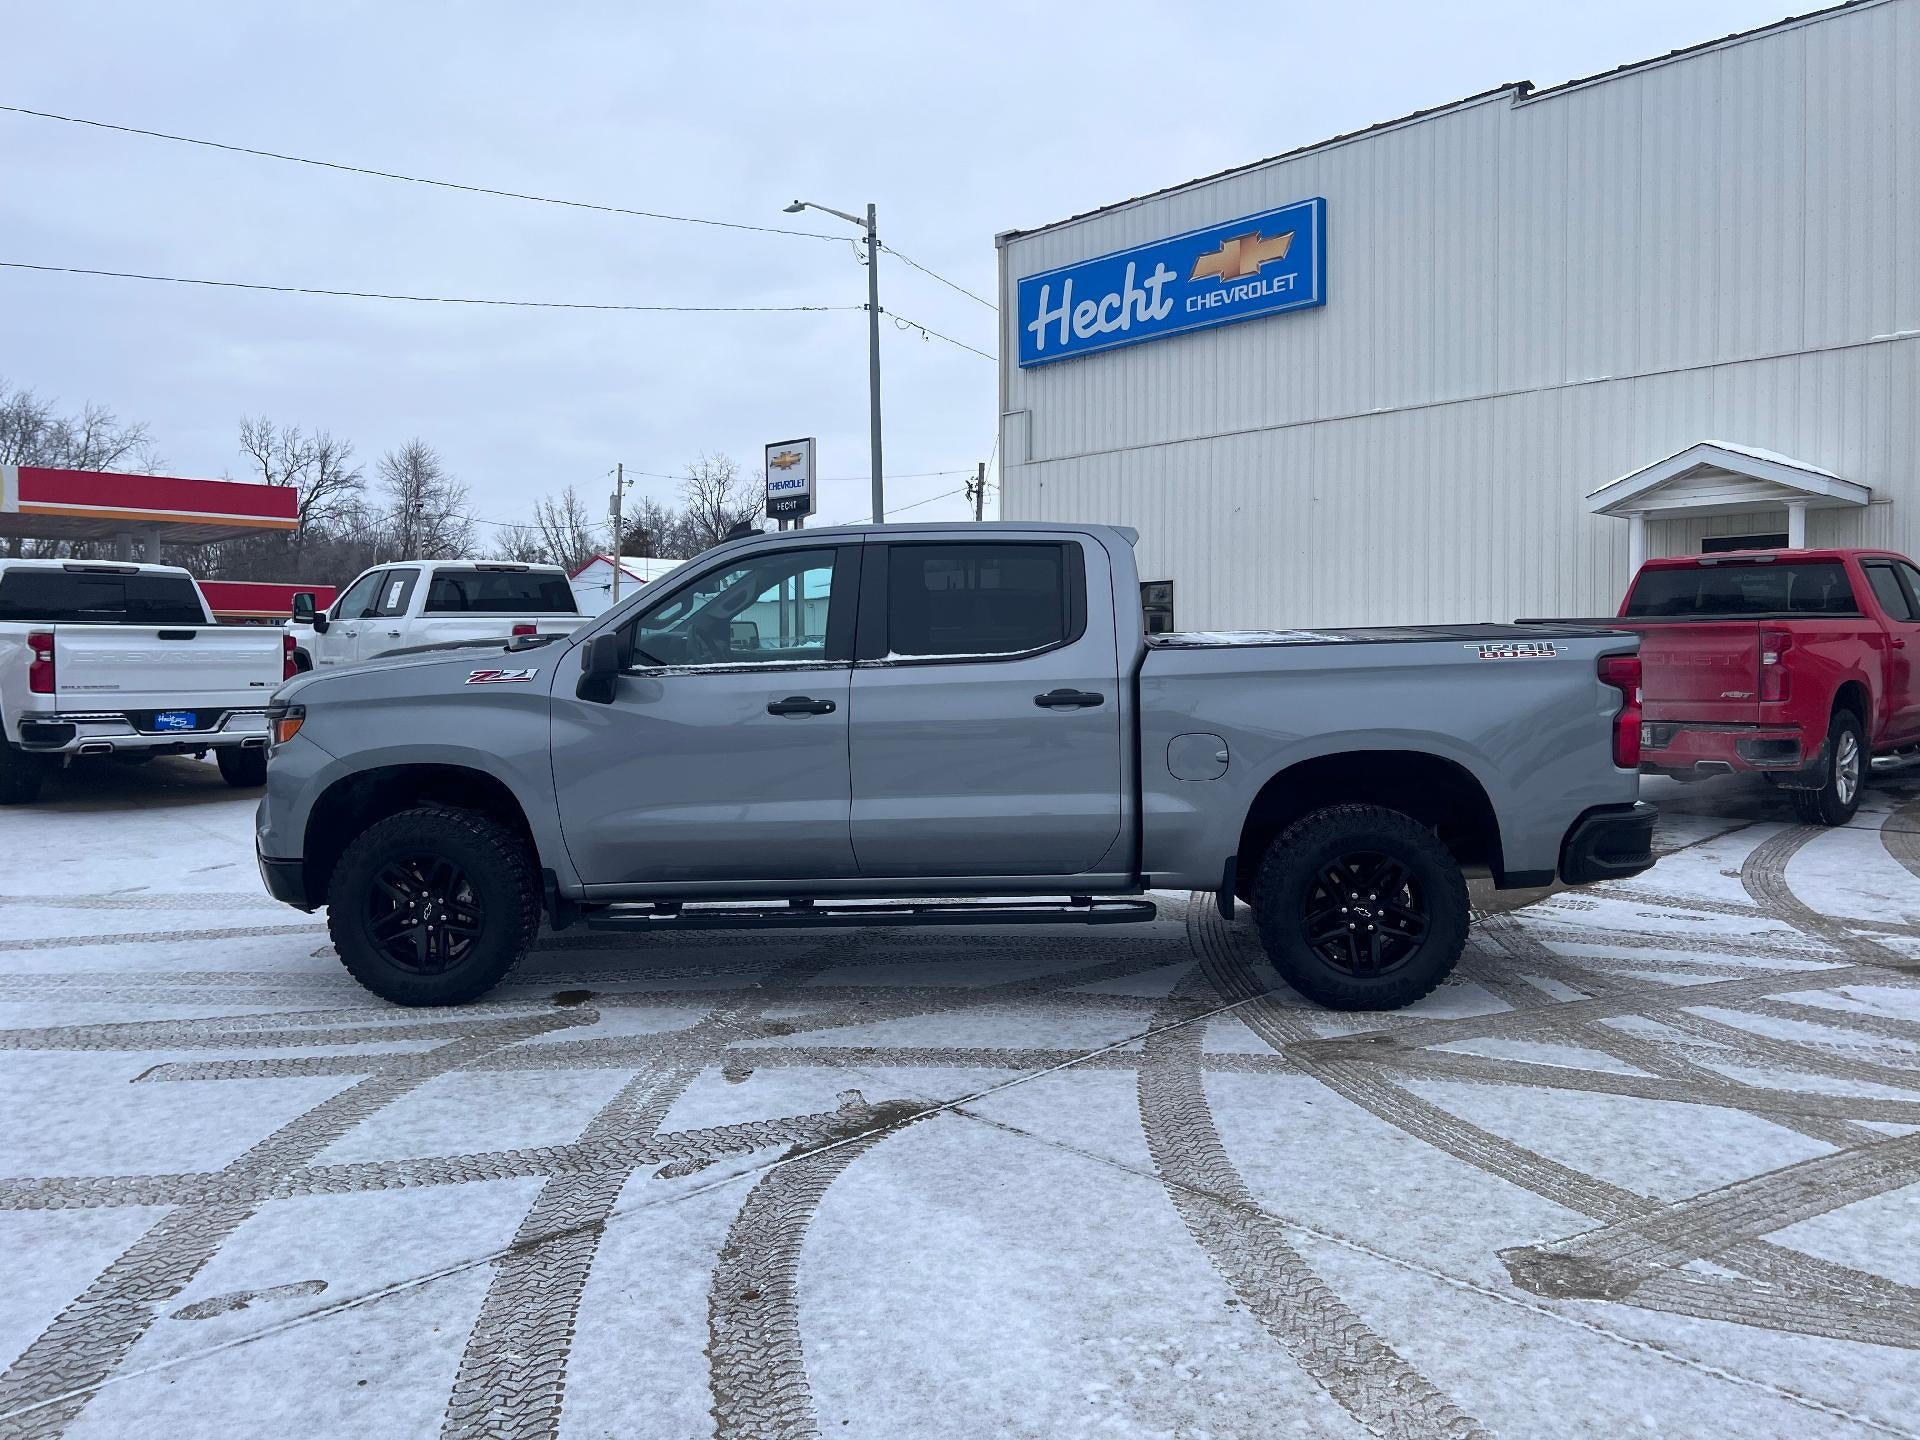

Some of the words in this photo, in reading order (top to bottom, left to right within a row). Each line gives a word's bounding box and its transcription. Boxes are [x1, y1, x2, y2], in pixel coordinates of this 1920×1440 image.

[1186, 272, 1298, 312] CHEVROLET
[1028, 261, 1177, 351] Hecht
[769, 478, 805, 491] CHEVROLET
[776, 500, 797, 511] HECHT
[464, 668, 539, 685] Z71
